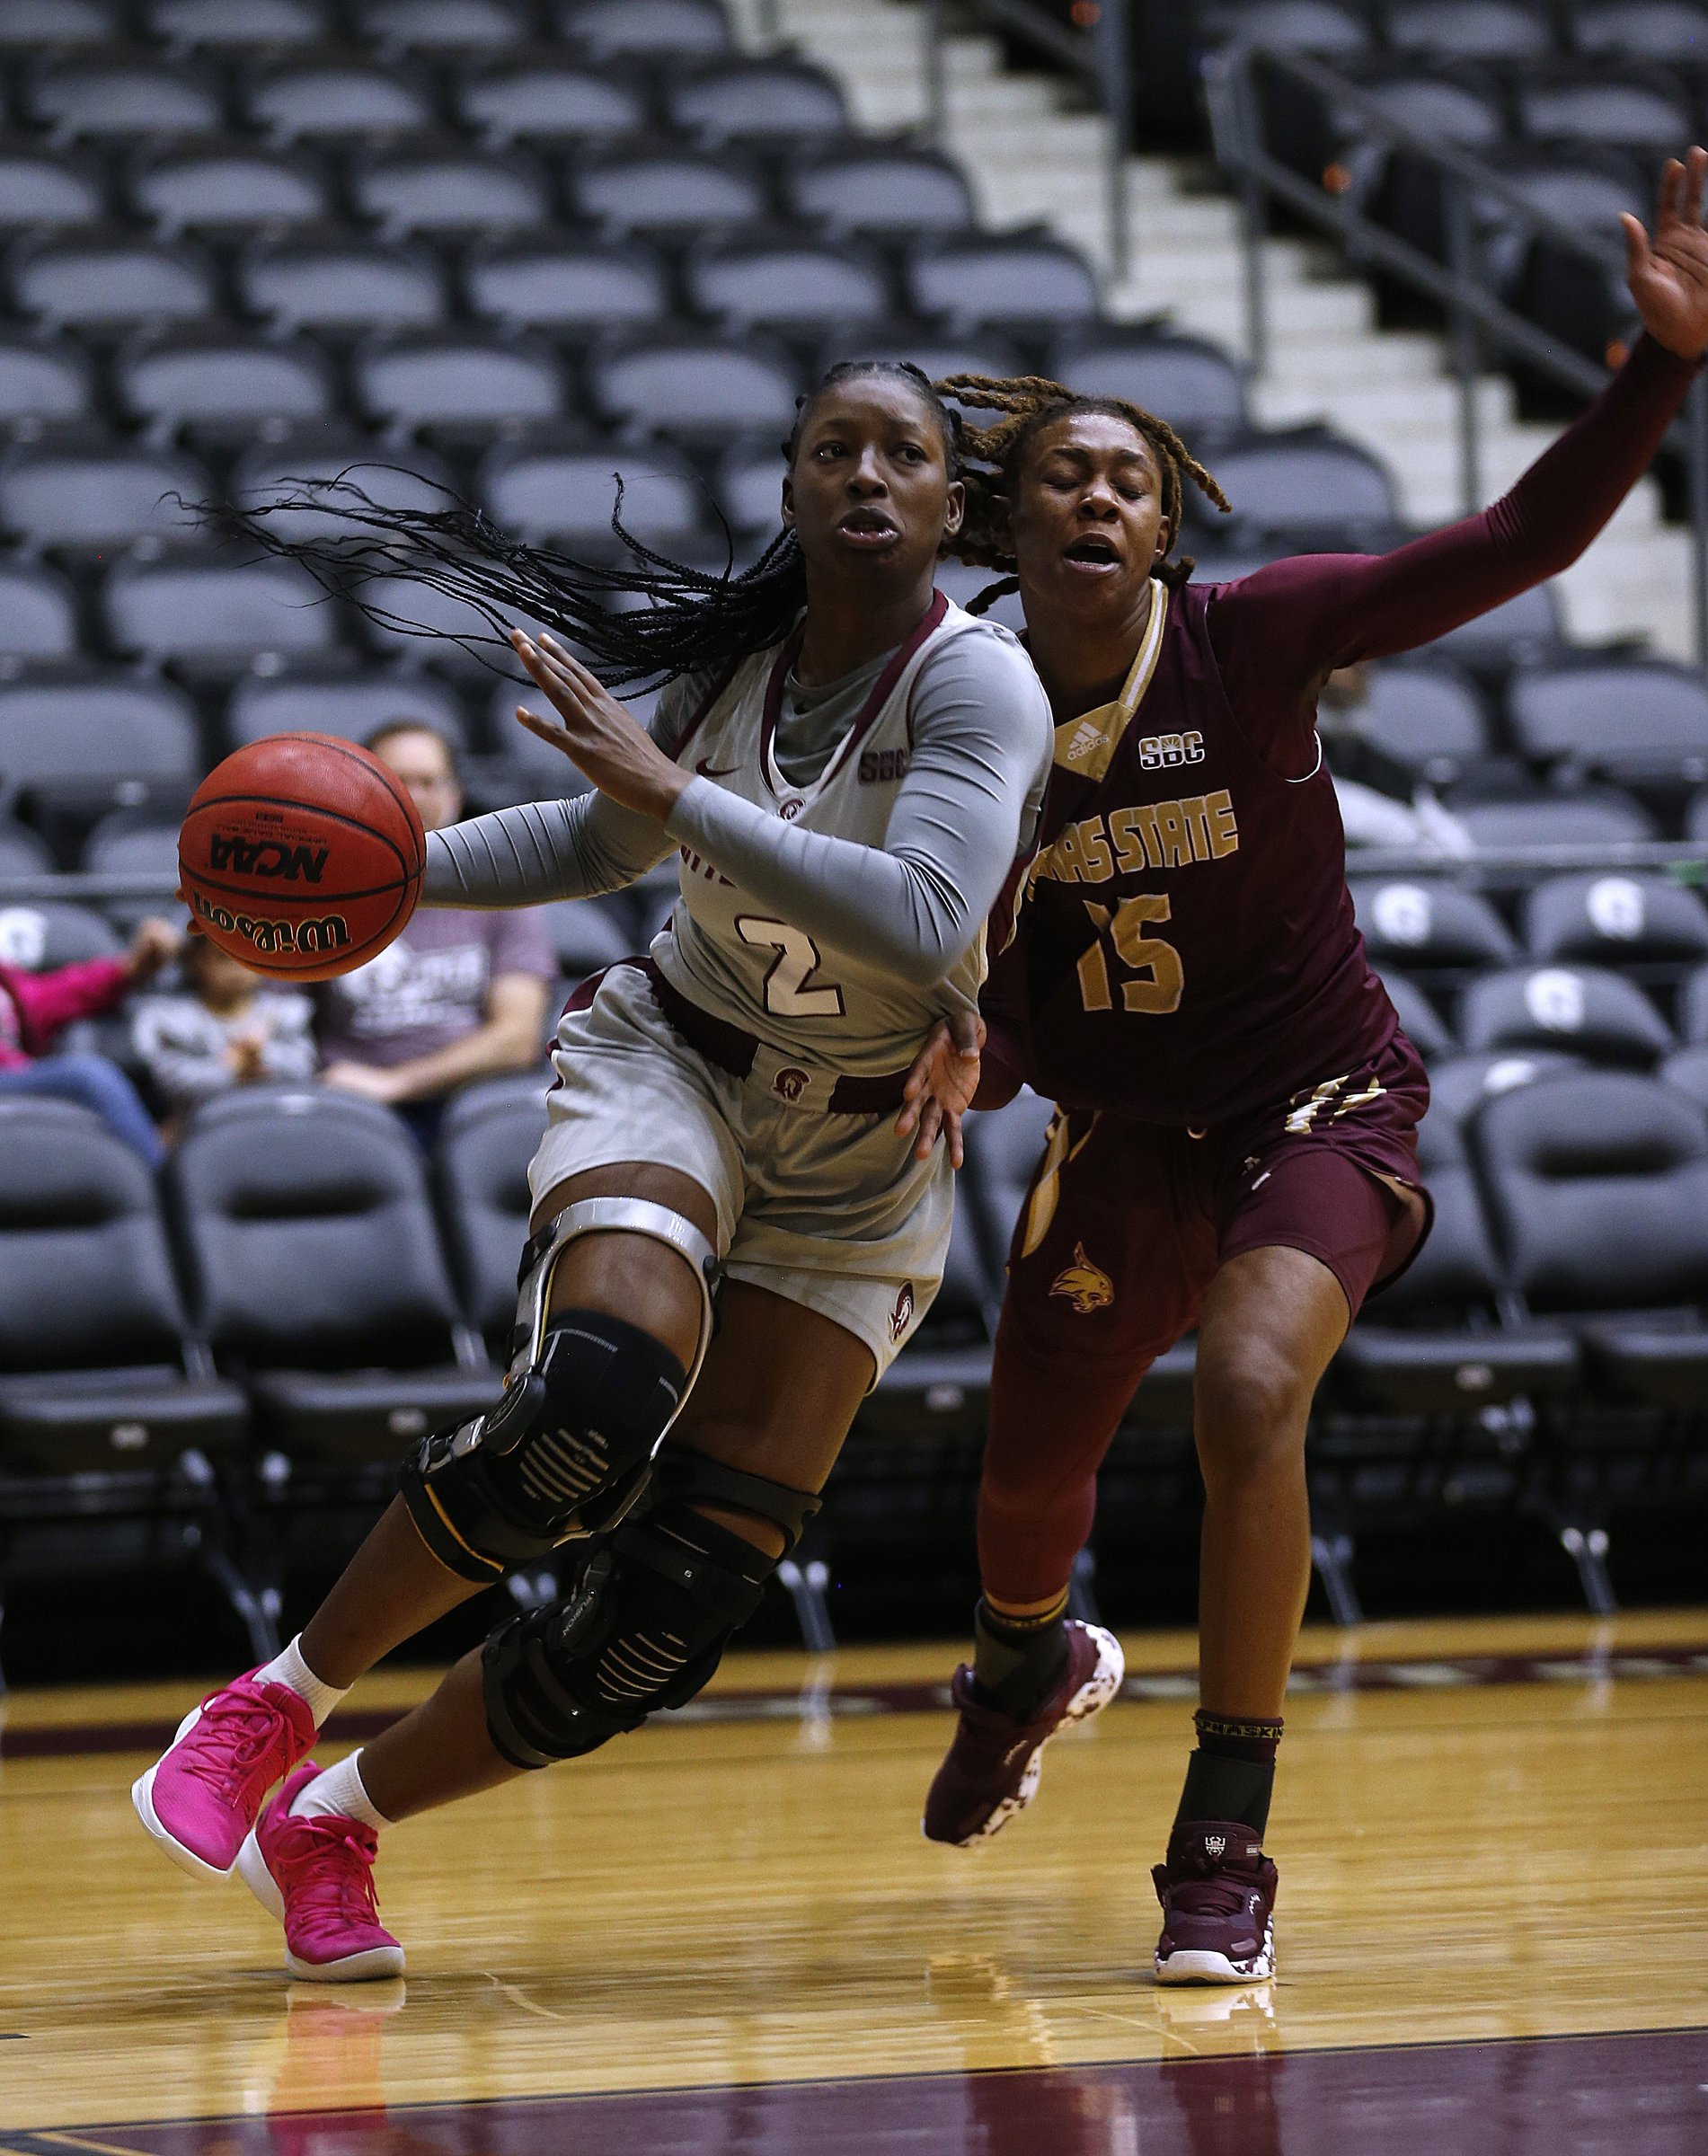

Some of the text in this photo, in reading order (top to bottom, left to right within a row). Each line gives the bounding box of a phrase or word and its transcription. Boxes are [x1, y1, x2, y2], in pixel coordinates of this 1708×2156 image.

[1067, 734, 1111, 761] adidas
[1138, 730, 1205, 770] SBC
[209, 833, 331, 885] NCAA
[1108, 789, 1239, 874] STATE
[192, 889, 353, 955] Wilson
[1076, 893, 1185, 1015] 15
[734, 914, 847, 1018] 2
